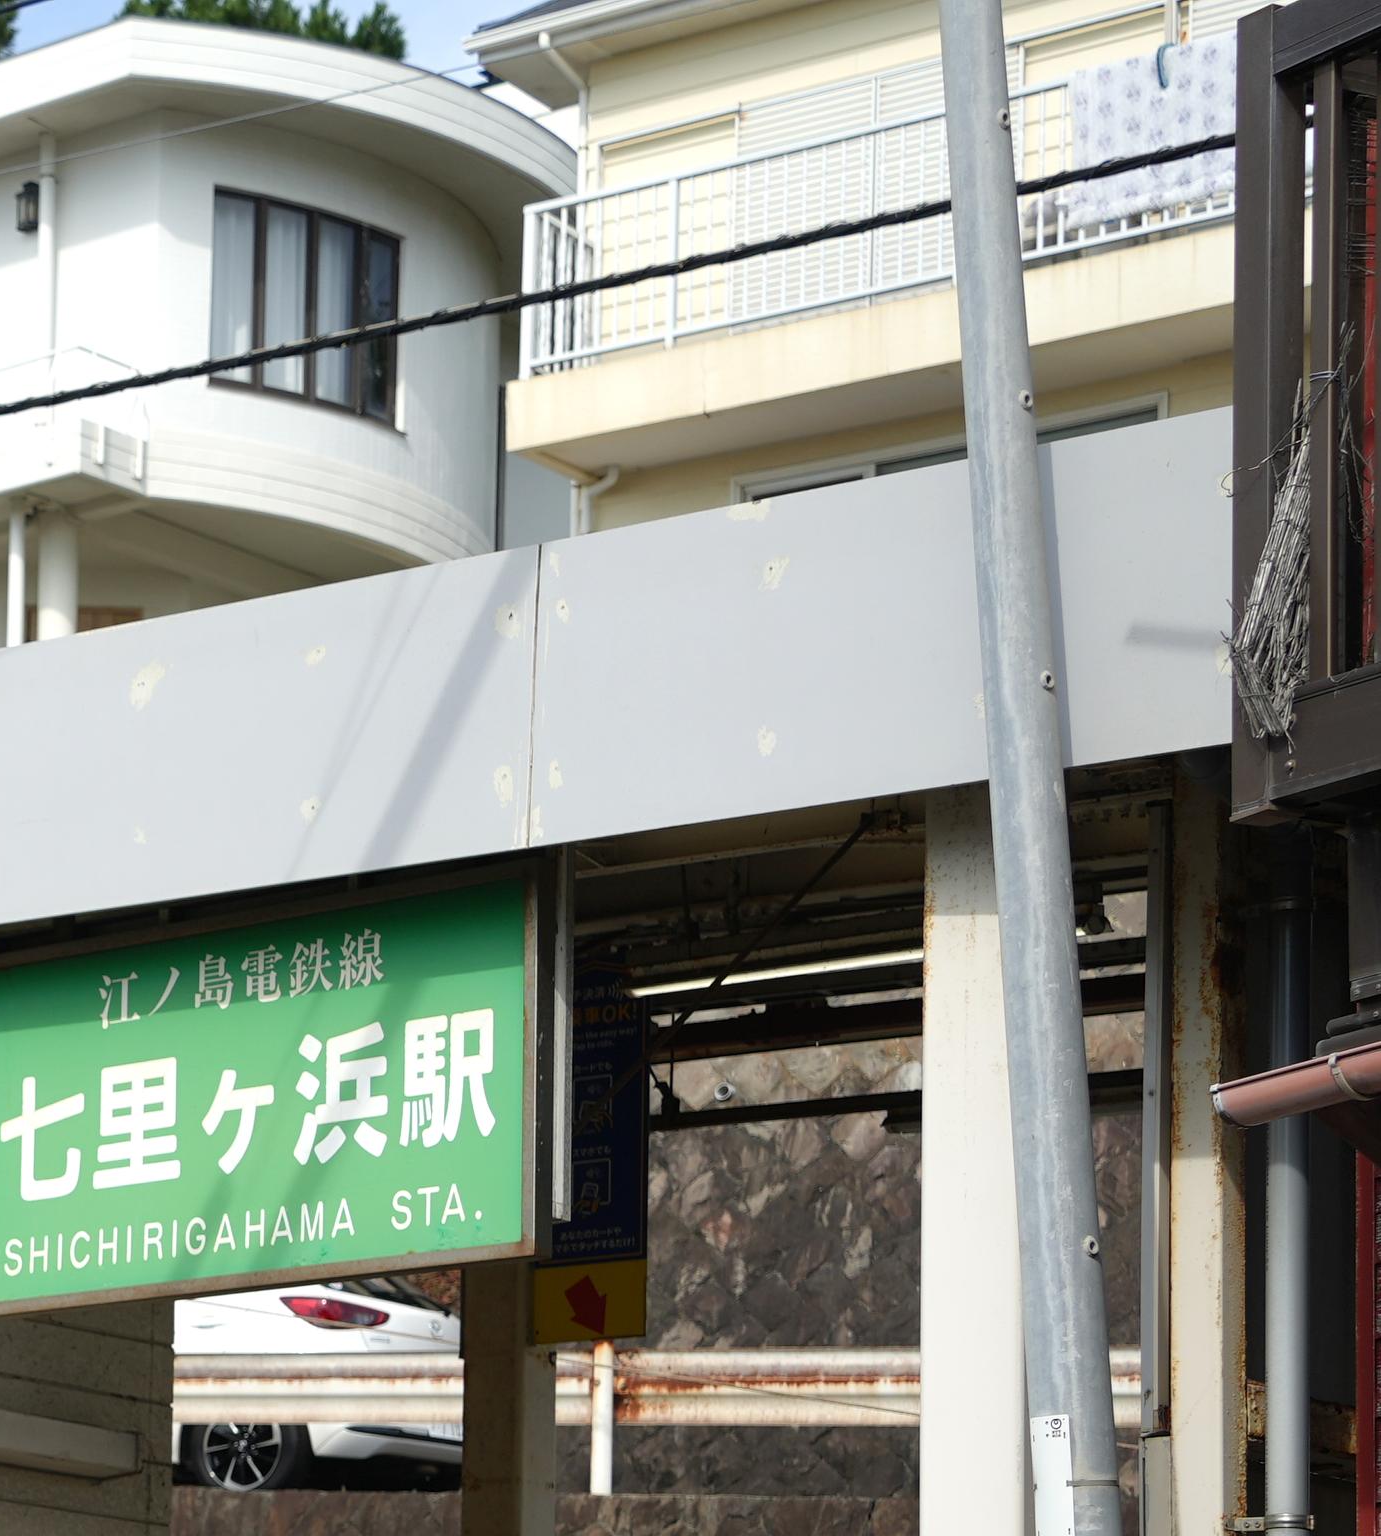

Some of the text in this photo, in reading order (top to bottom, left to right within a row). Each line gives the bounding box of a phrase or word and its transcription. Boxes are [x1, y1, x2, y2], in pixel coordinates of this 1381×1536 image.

[98, 928, 384, 1029] 江ノ島電鉄線
[4, 1183, 484, 1277] SHICHIRIGAHAMA STA.
